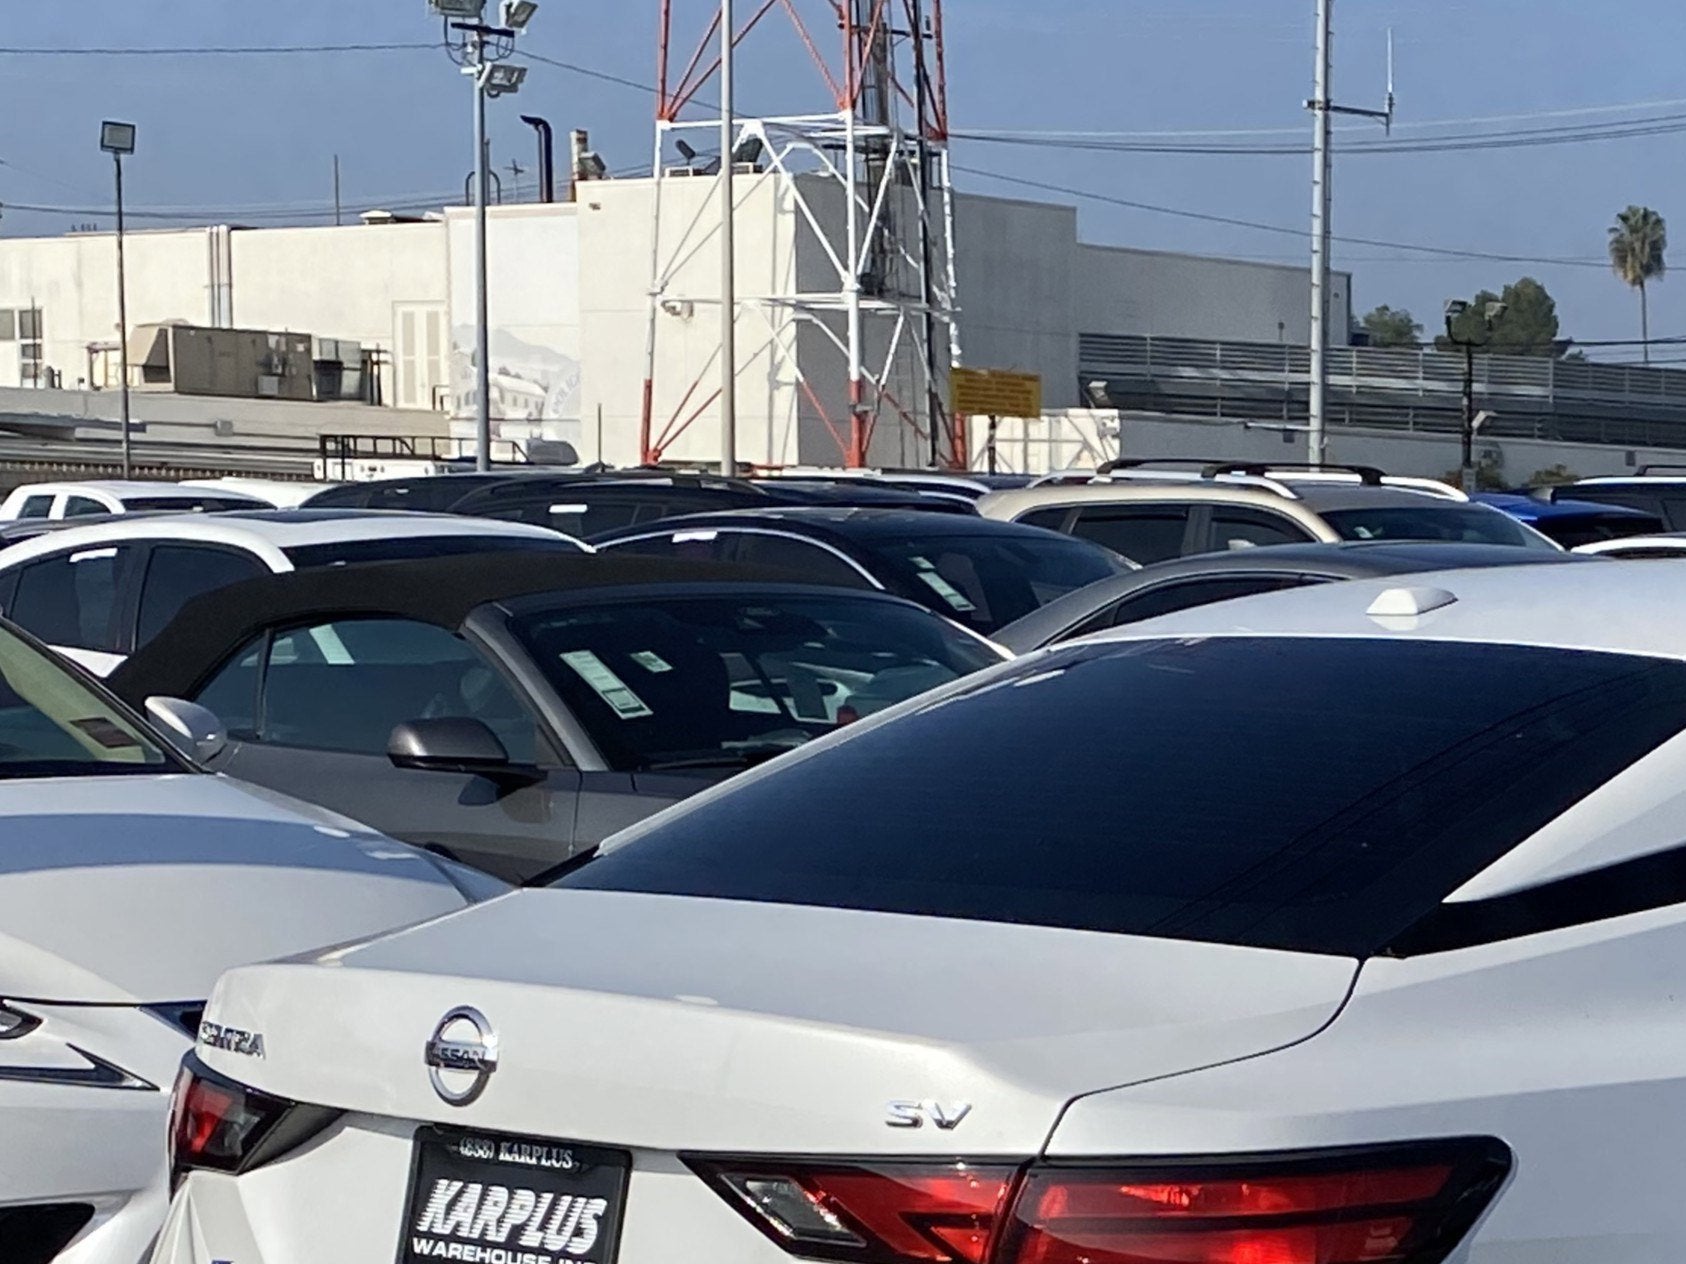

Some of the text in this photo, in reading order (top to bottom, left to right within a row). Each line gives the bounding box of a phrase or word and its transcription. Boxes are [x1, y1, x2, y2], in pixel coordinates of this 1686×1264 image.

[884, 1099, 973, 1131] SV
[499, 1142, 574, 1168] KARPLUS
[416, 1178, 608, 1254] KARPLUS
